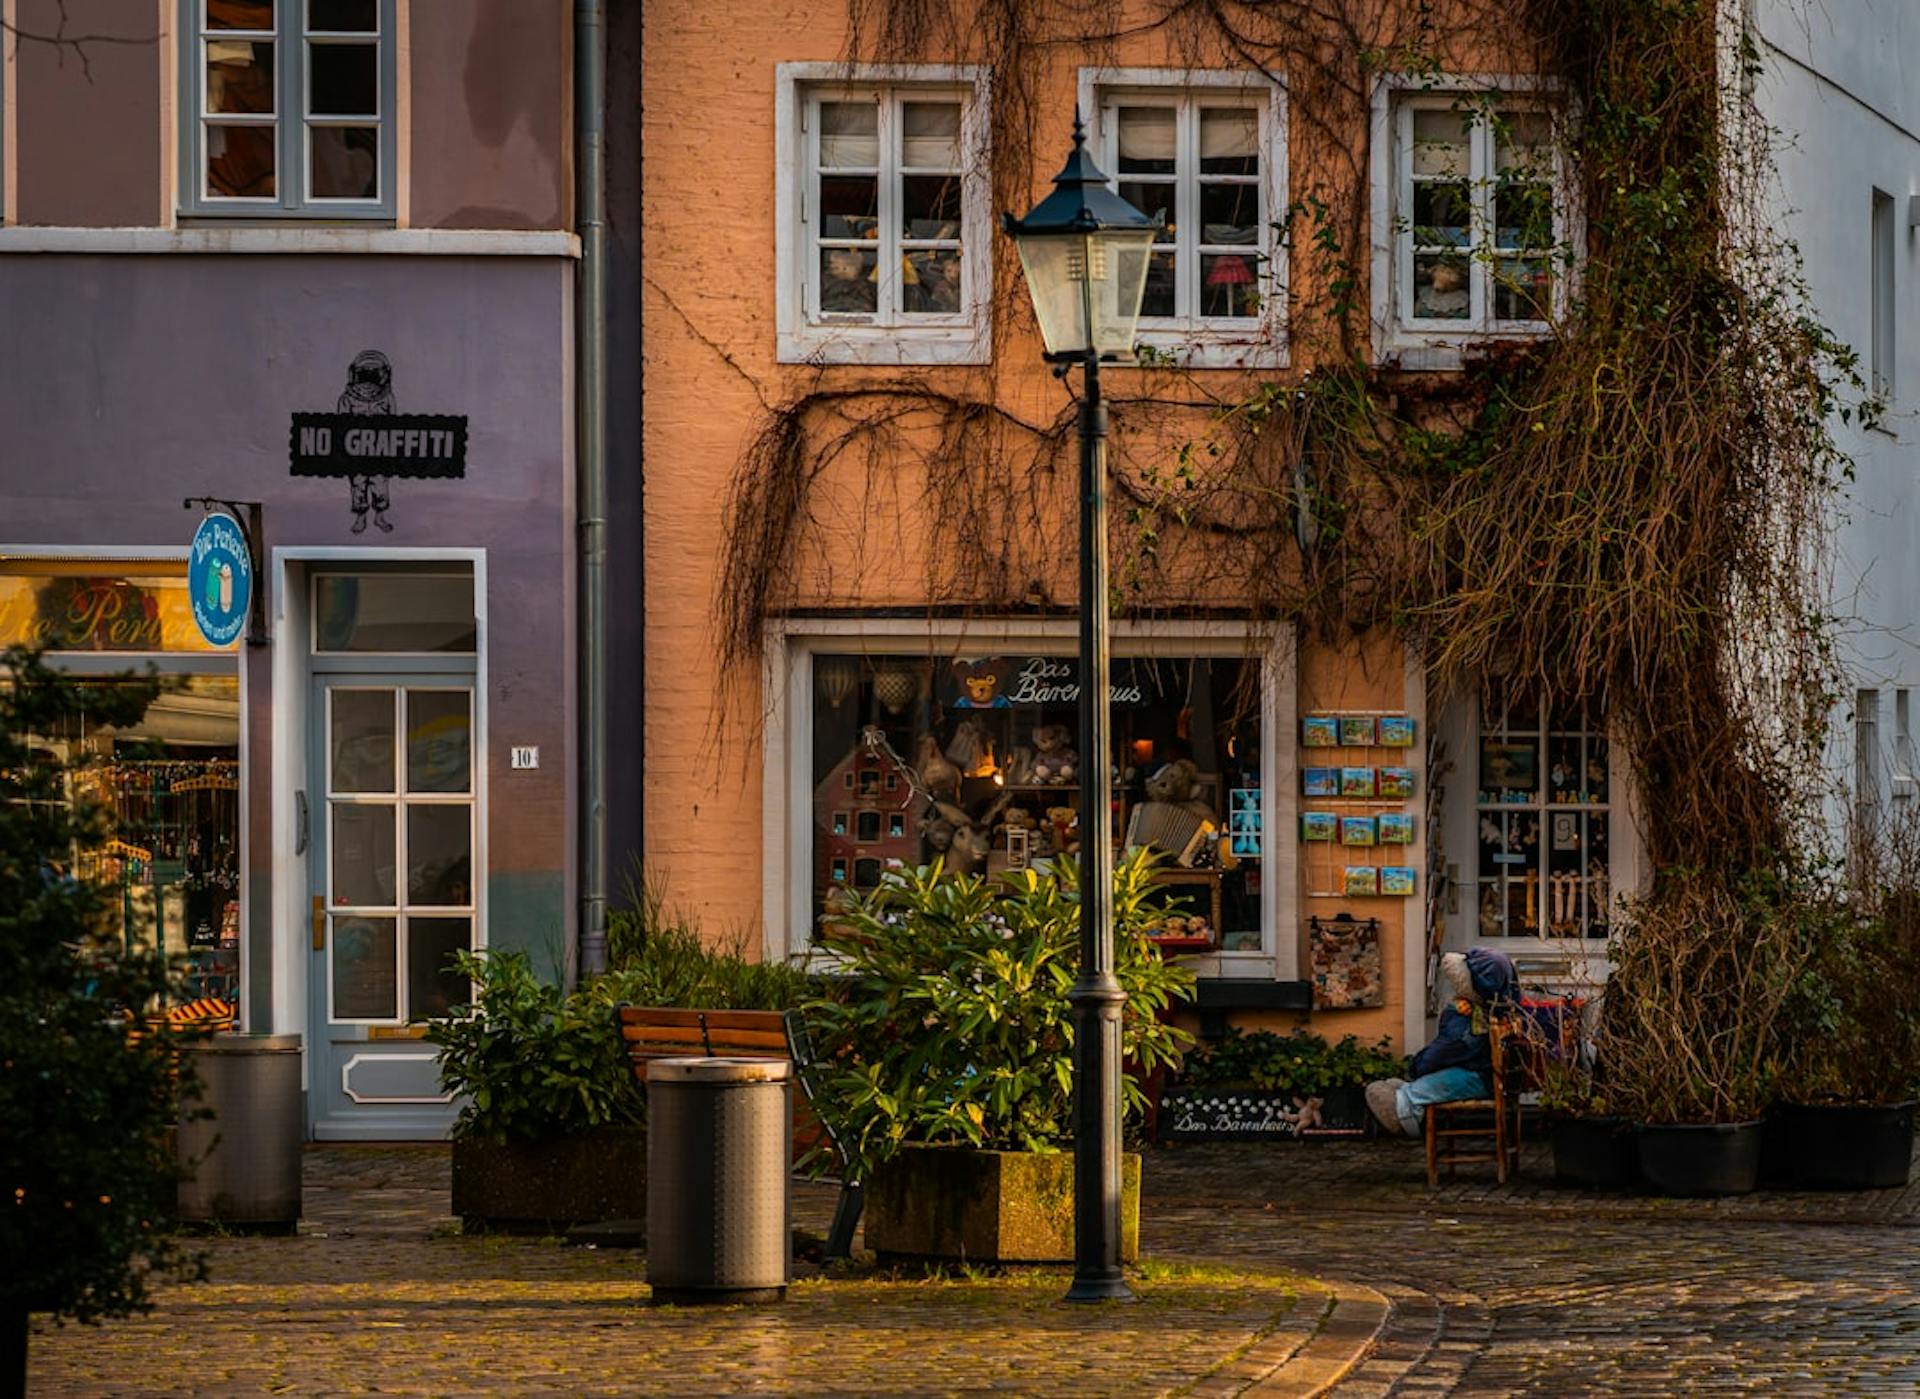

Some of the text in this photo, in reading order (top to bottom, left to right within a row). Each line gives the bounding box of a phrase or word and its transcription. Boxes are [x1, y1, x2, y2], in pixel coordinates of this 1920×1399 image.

[299, 427, 455, 459] NO GRAFFITI
[195, 531, 213, 564] Die
[1019, 656, 1072, 679] Das
[517, 749, 531, 767] 10
[1556, 818, 1571, 843] 9
[1171, 1111, 1208, 1133] Das
